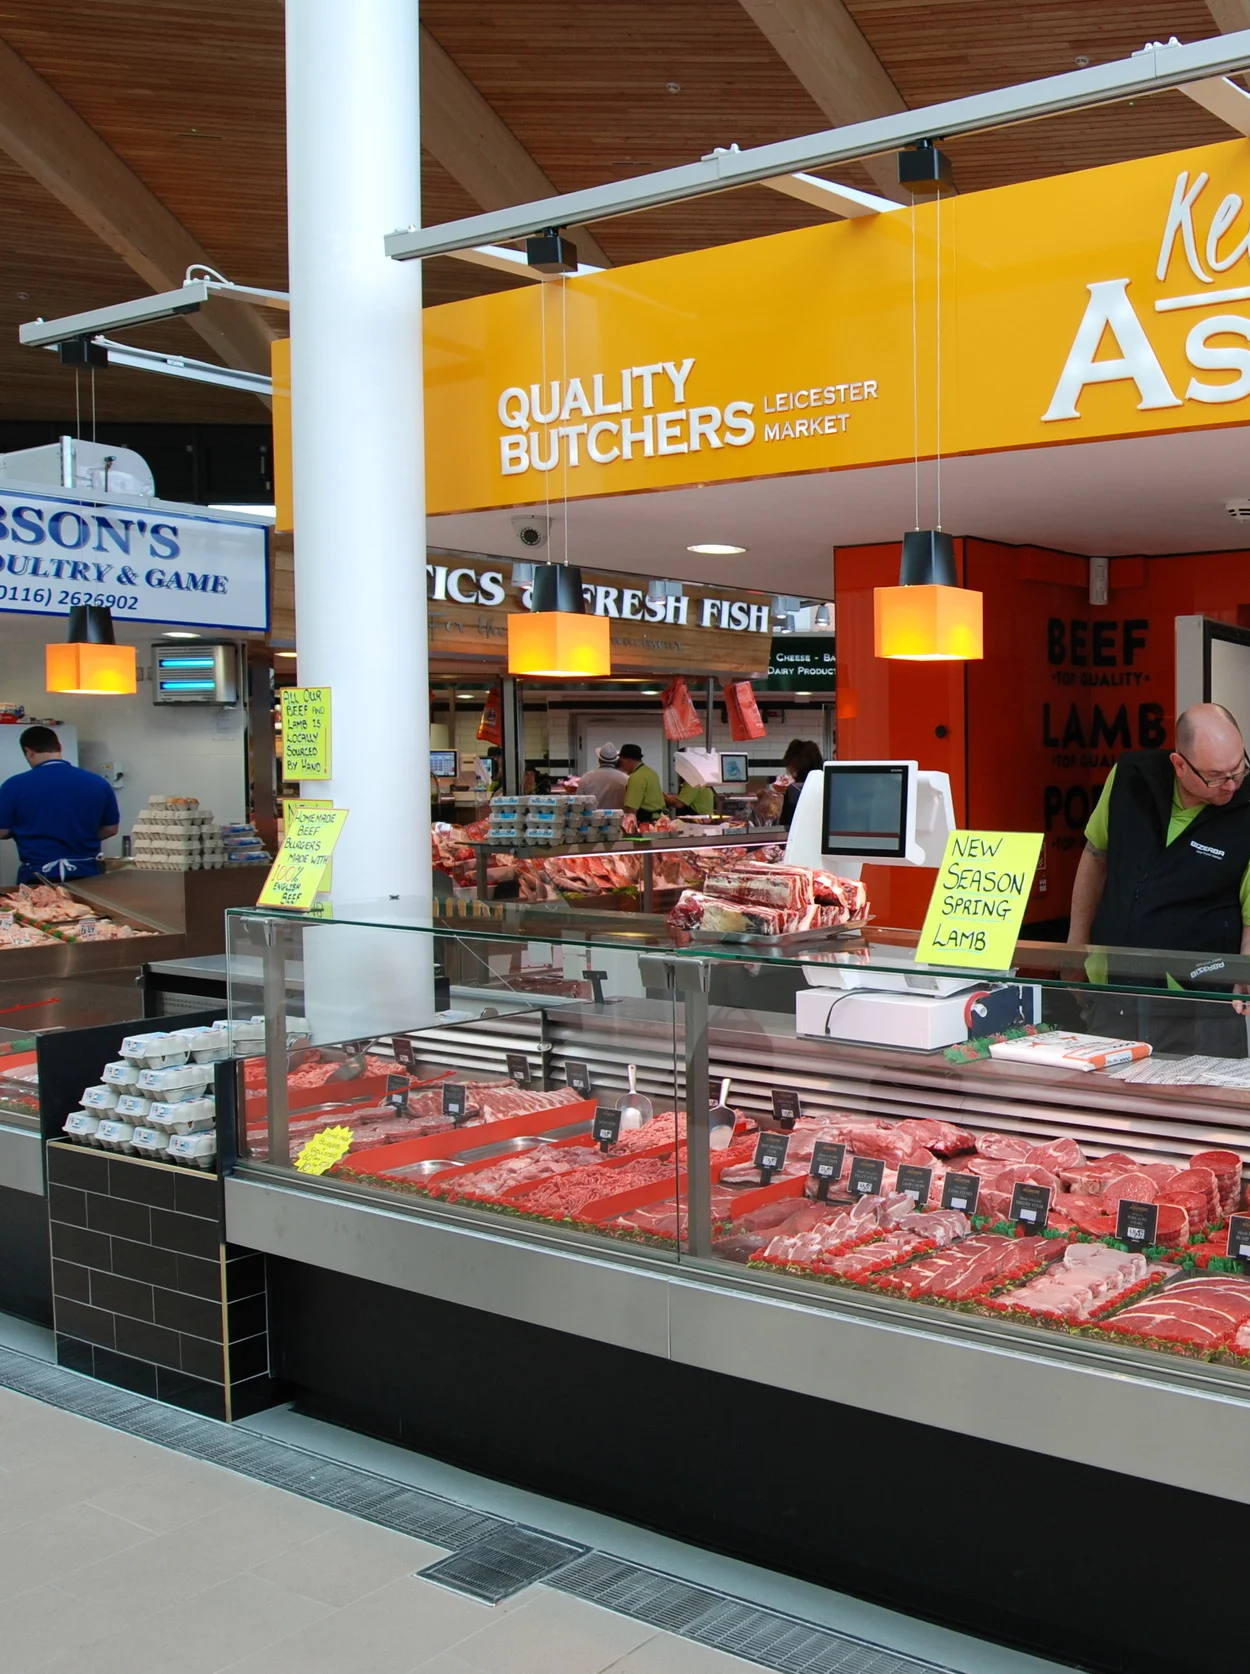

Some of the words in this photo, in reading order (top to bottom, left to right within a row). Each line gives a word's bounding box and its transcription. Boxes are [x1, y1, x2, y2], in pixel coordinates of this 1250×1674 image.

[497, 358, 696, 432] QUALITY
[763, 379, 879, 414] LEICESTER
[499, 401, 756, 476] BUTCHERS
[763, 413, 851, 442] MARKET
[117, 566, 139, 586] &
[145, 567, 229, 595] GAME
[701, 597, 770, 633] FISH
[1047, 618, 1149, 667] BEEF
[767, 666, 794, 675] DAIRY
[283, 691, 299, 704] ALL
[303, 689, 322, 703] OUR
[286, 705, 308, 717] BEEF
[288, 719, 308, 730] LAMB
[312, 719, 321, 729] IS
[1043, 702, 1167, 749] LAMB
[287, 733, 319, 744] LOCALLY
[286, 745, 318, 757] SOURCED
[287, 760, 298, 771] BY
[301, 759, 321, 773] HAND
[297, 825, 320, 836] BEEF
[284, 837, 321, 851] BURGERS
[951, 836, 1003, 858] NEW
[288, 853, 309, 863] MADE
[311, 855, 329, 865] WITH
[943, 862, 1025, 895] SEASON
[942, 895, 1012, 920] SPRING
[932, 923, 986, 951] LAMB
